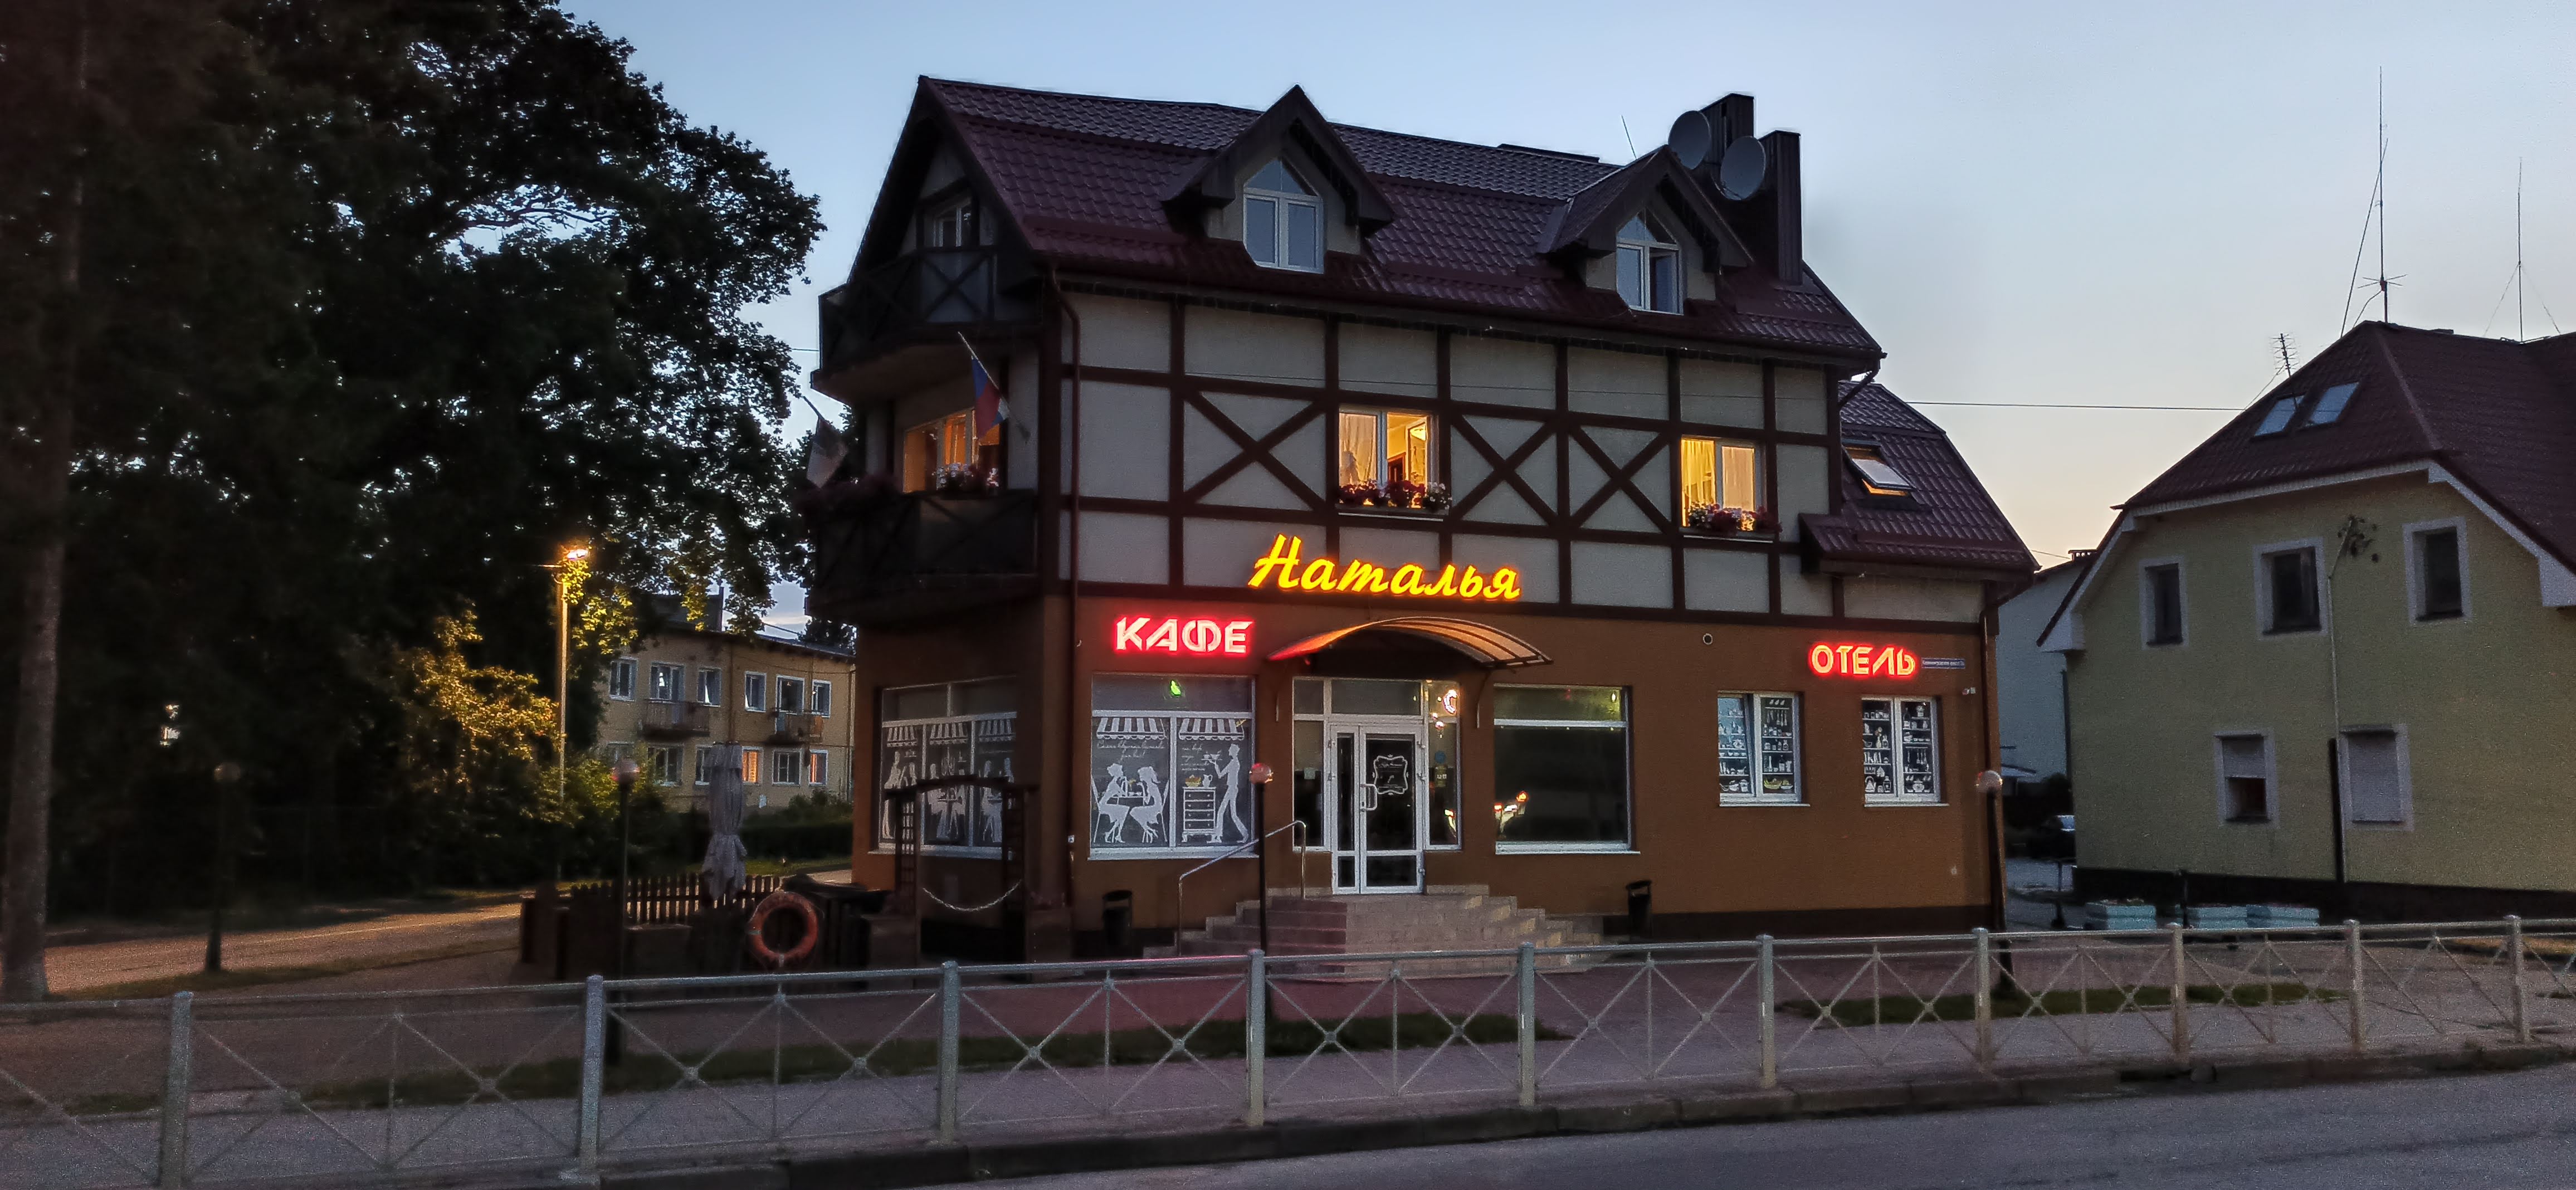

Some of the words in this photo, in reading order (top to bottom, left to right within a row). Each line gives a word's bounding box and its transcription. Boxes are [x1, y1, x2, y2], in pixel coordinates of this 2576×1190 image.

[1247, 533, 1521, 599] Наталья
[1115, 616, 1253, 654] КАФЕ
[1811, 644, 1916, 676] ОТЕЛЬ
